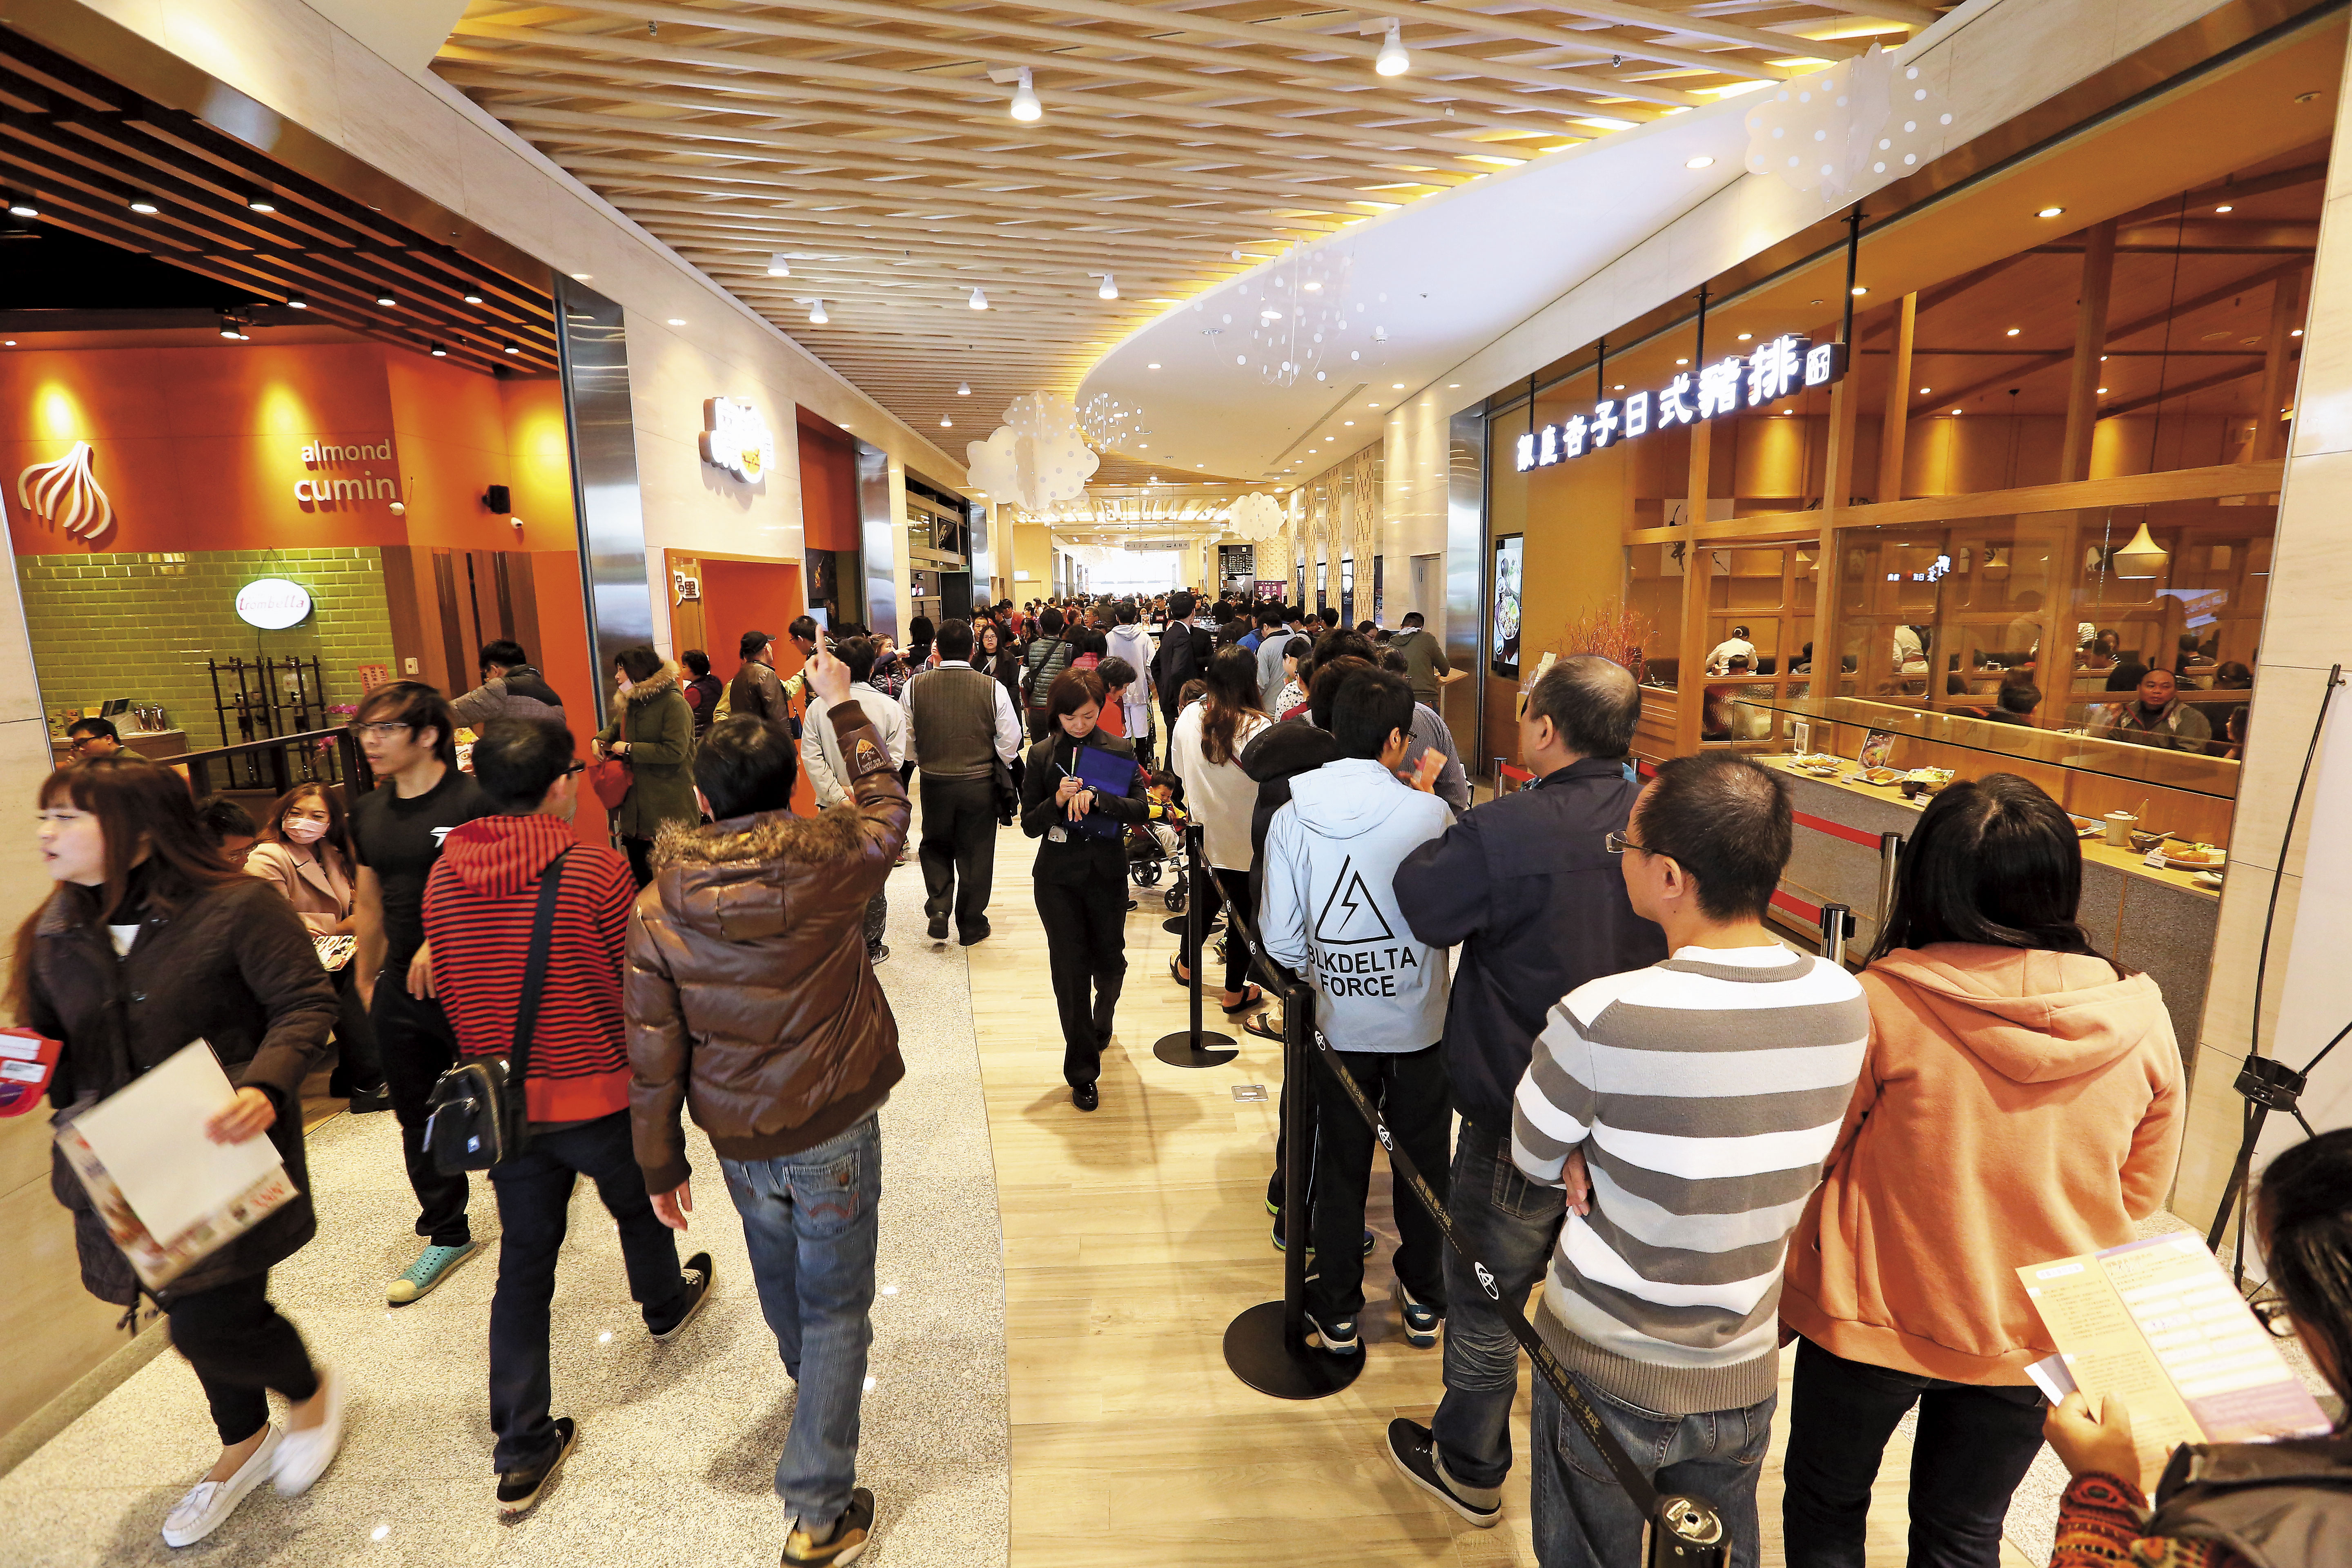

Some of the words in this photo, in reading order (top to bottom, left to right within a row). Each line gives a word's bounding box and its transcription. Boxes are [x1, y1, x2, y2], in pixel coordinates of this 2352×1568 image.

[301, 438, 392, 462] almond
[294, 470, 396, 501] cumin
[239, 595, 304, 610] trombella
[1307, 942, 1418, 974] BLKDELTA
[1320, 975, 1396, 997] FORCE
